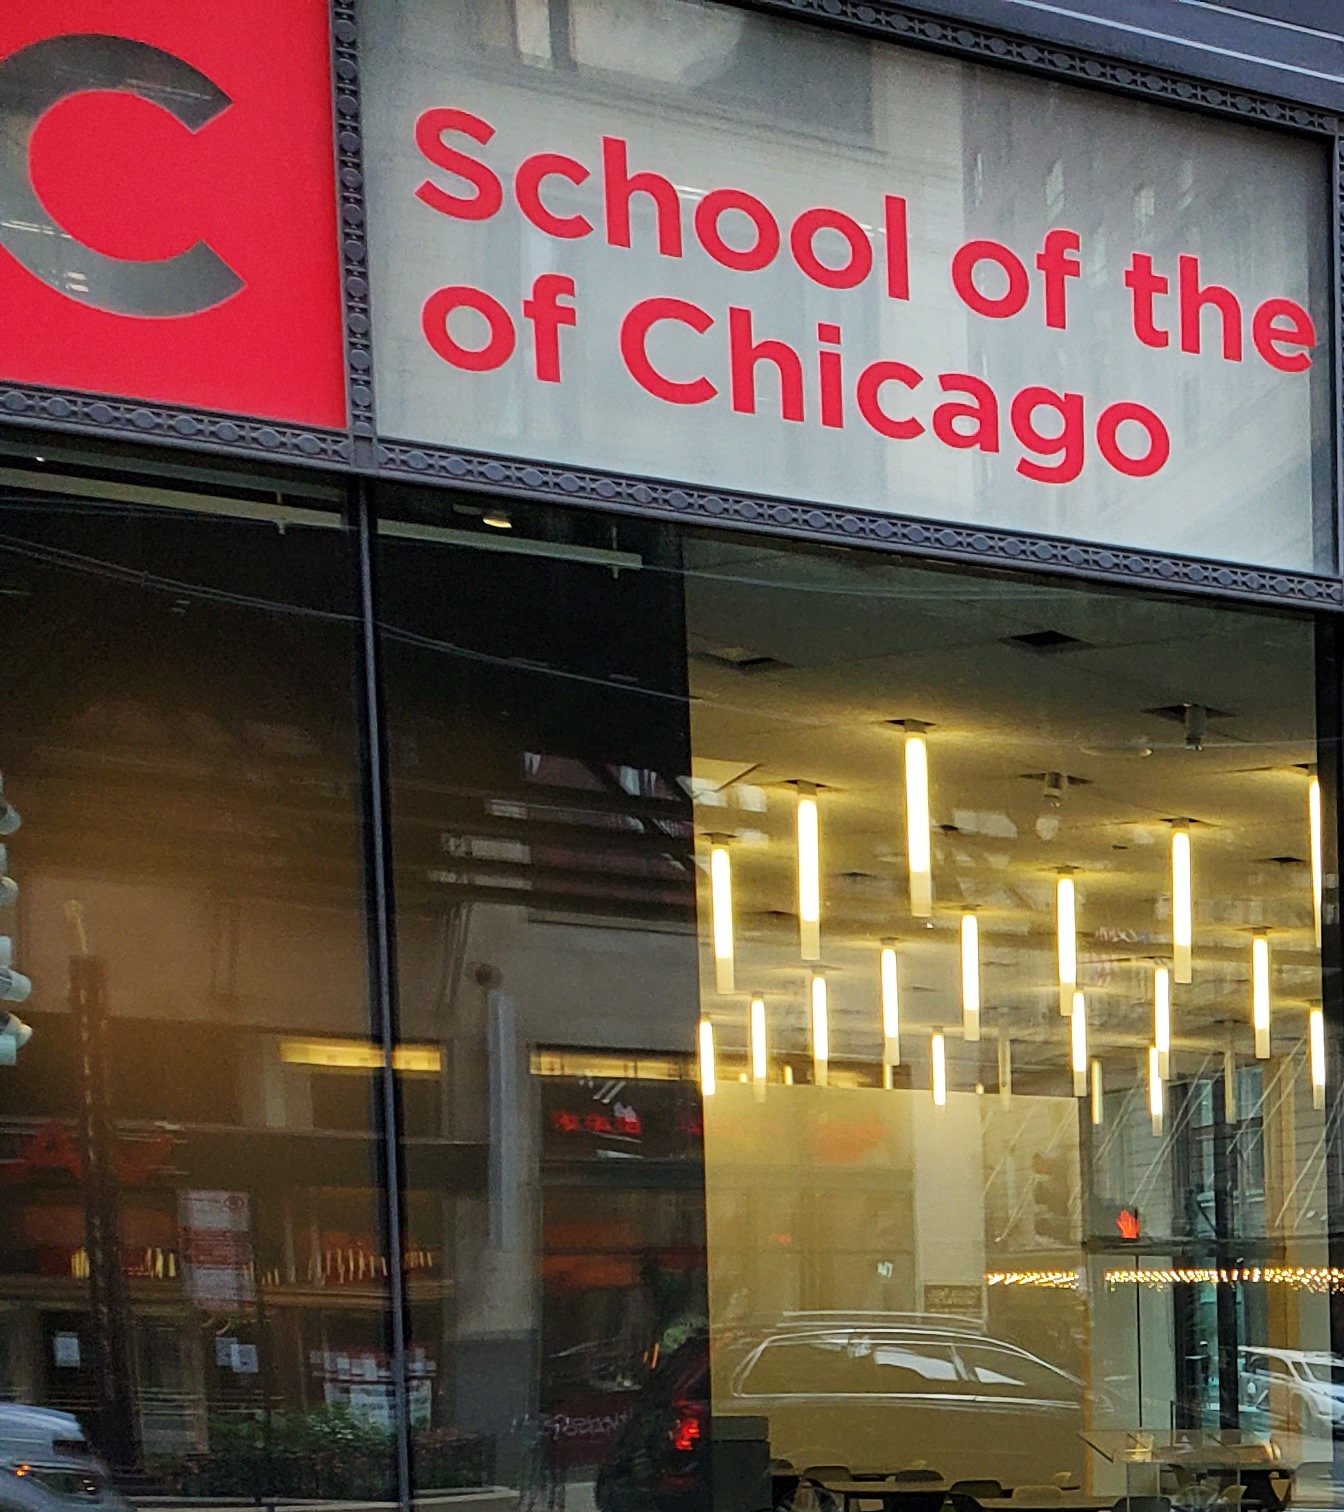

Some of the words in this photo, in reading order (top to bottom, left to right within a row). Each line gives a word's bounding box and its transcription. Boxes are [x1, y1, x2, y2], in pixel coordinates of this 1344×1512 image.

[413, 107, 910, 301] School
[952, 229, 1081, 330] of
[1124, 252, 1318, 374] the
[421, 274, 577, 384] of
[620, 297, 1171, 484] Chicago
